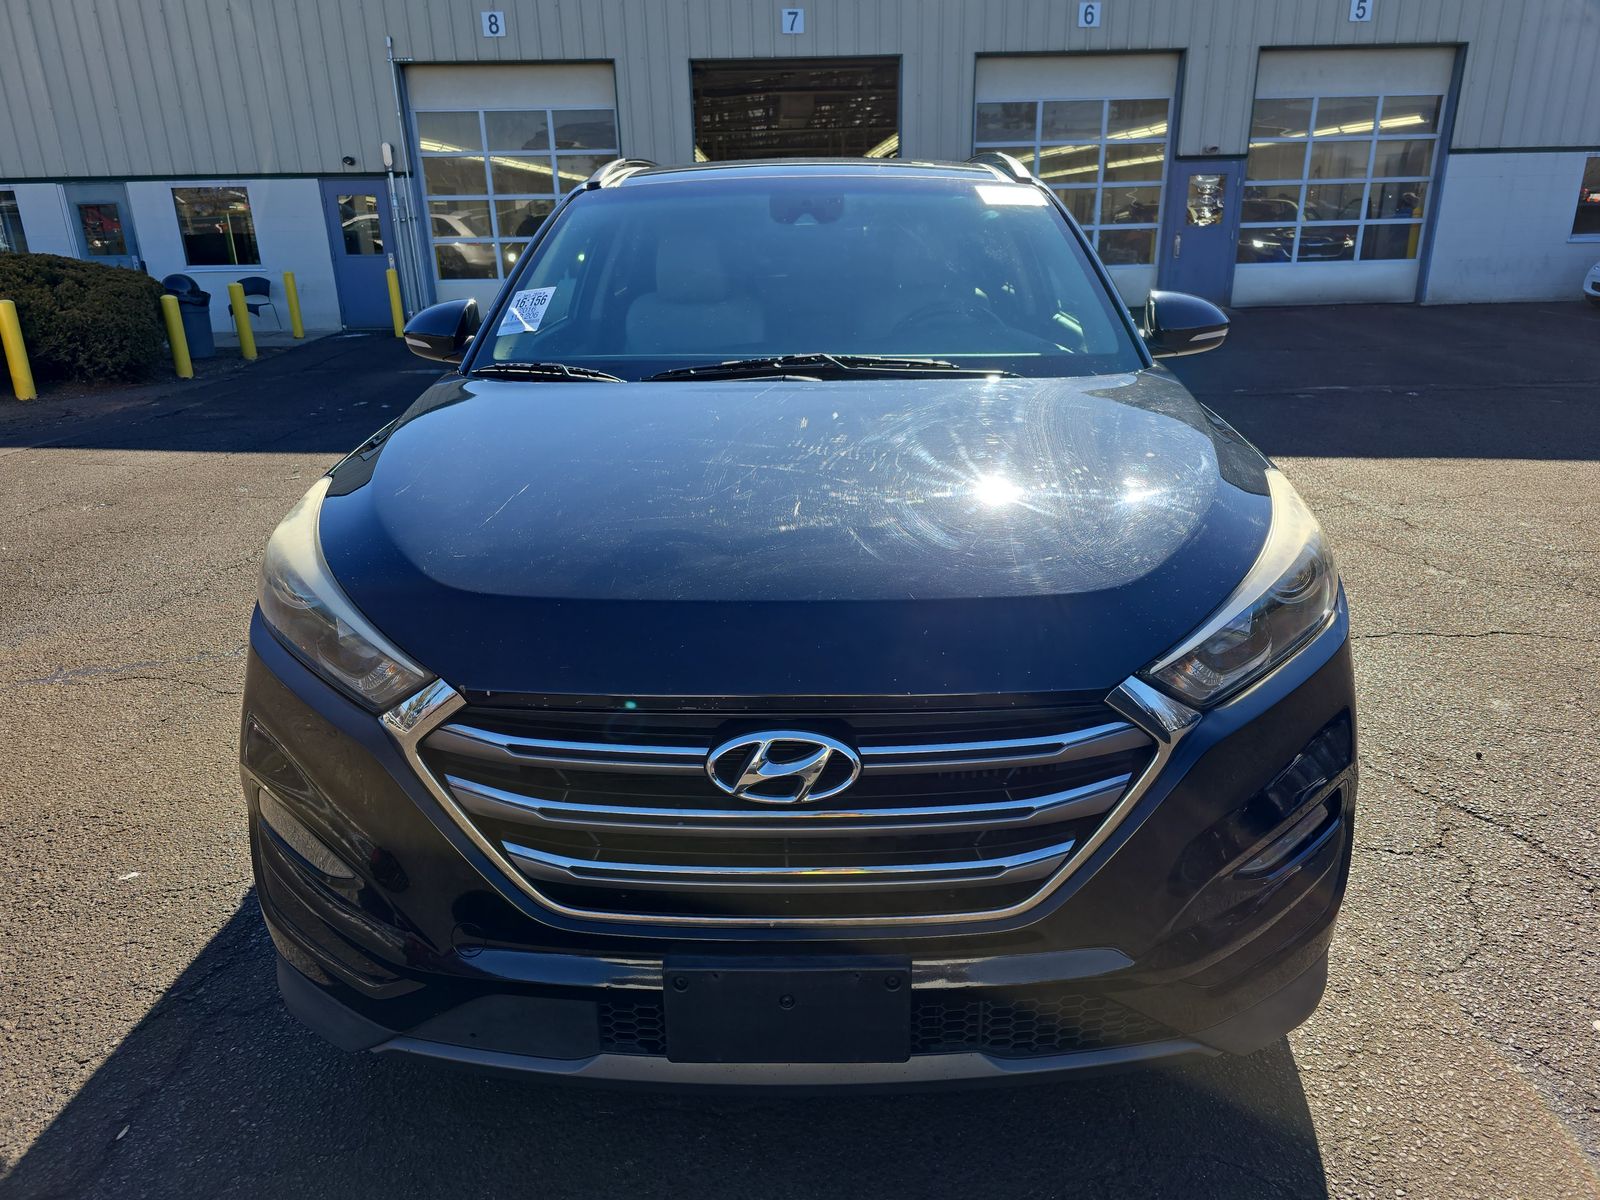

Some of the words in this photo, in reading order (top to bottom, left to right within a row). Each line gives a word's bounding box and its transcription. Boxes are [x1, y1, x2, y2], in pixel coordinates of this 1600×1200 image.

[1084, 4, 1095, 24] 6
[1355, 0, 1367, 19] 5
[488, 14, 499, 34] 8
[787, 11, 799, 31] 7
